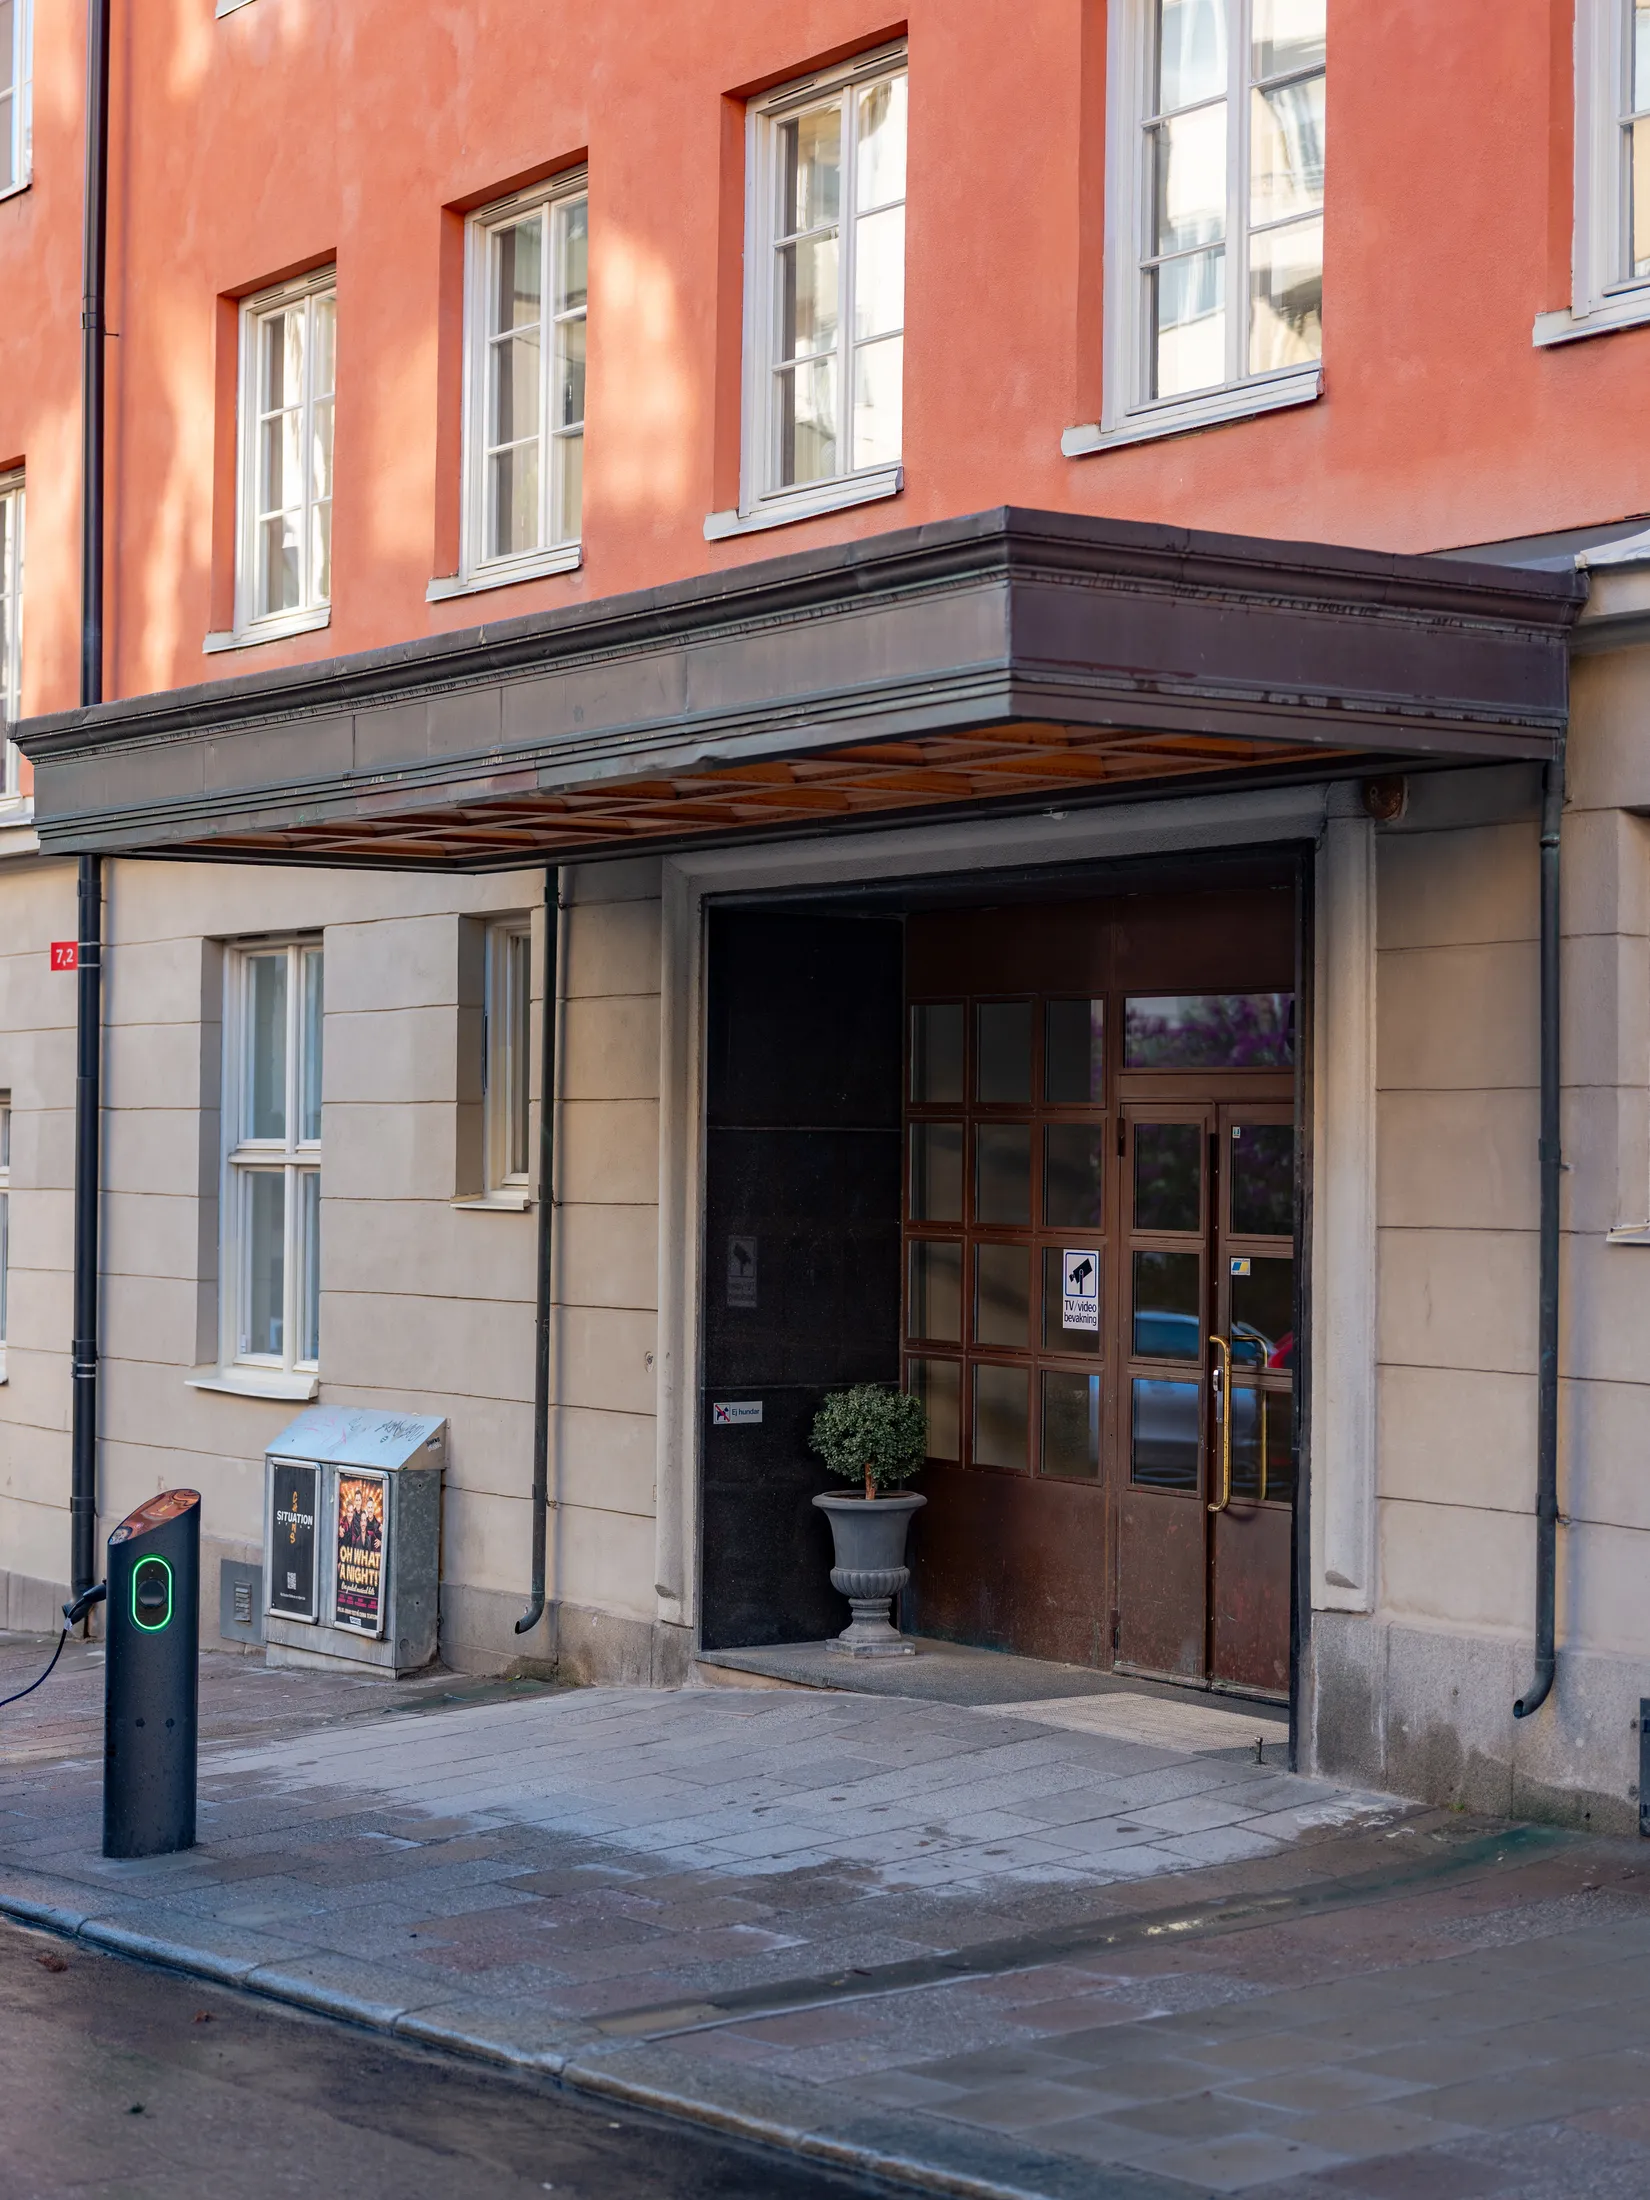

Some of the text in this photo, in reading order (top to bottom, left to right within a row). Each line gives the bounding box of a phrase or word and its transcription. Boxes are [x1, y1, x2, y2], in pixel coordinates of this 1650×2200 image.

[56, 948, 74, 966] 7,2
[1064, 1300, 1097, 1313] TV/video
[1064, 1312, 1097, 1327] bevakning
[276, 1510, 313, 1526] SITUATION
[340, 1546, 381, 1569] OH WHAT
[340, 1563, 379, 1587] A NIGHT!
